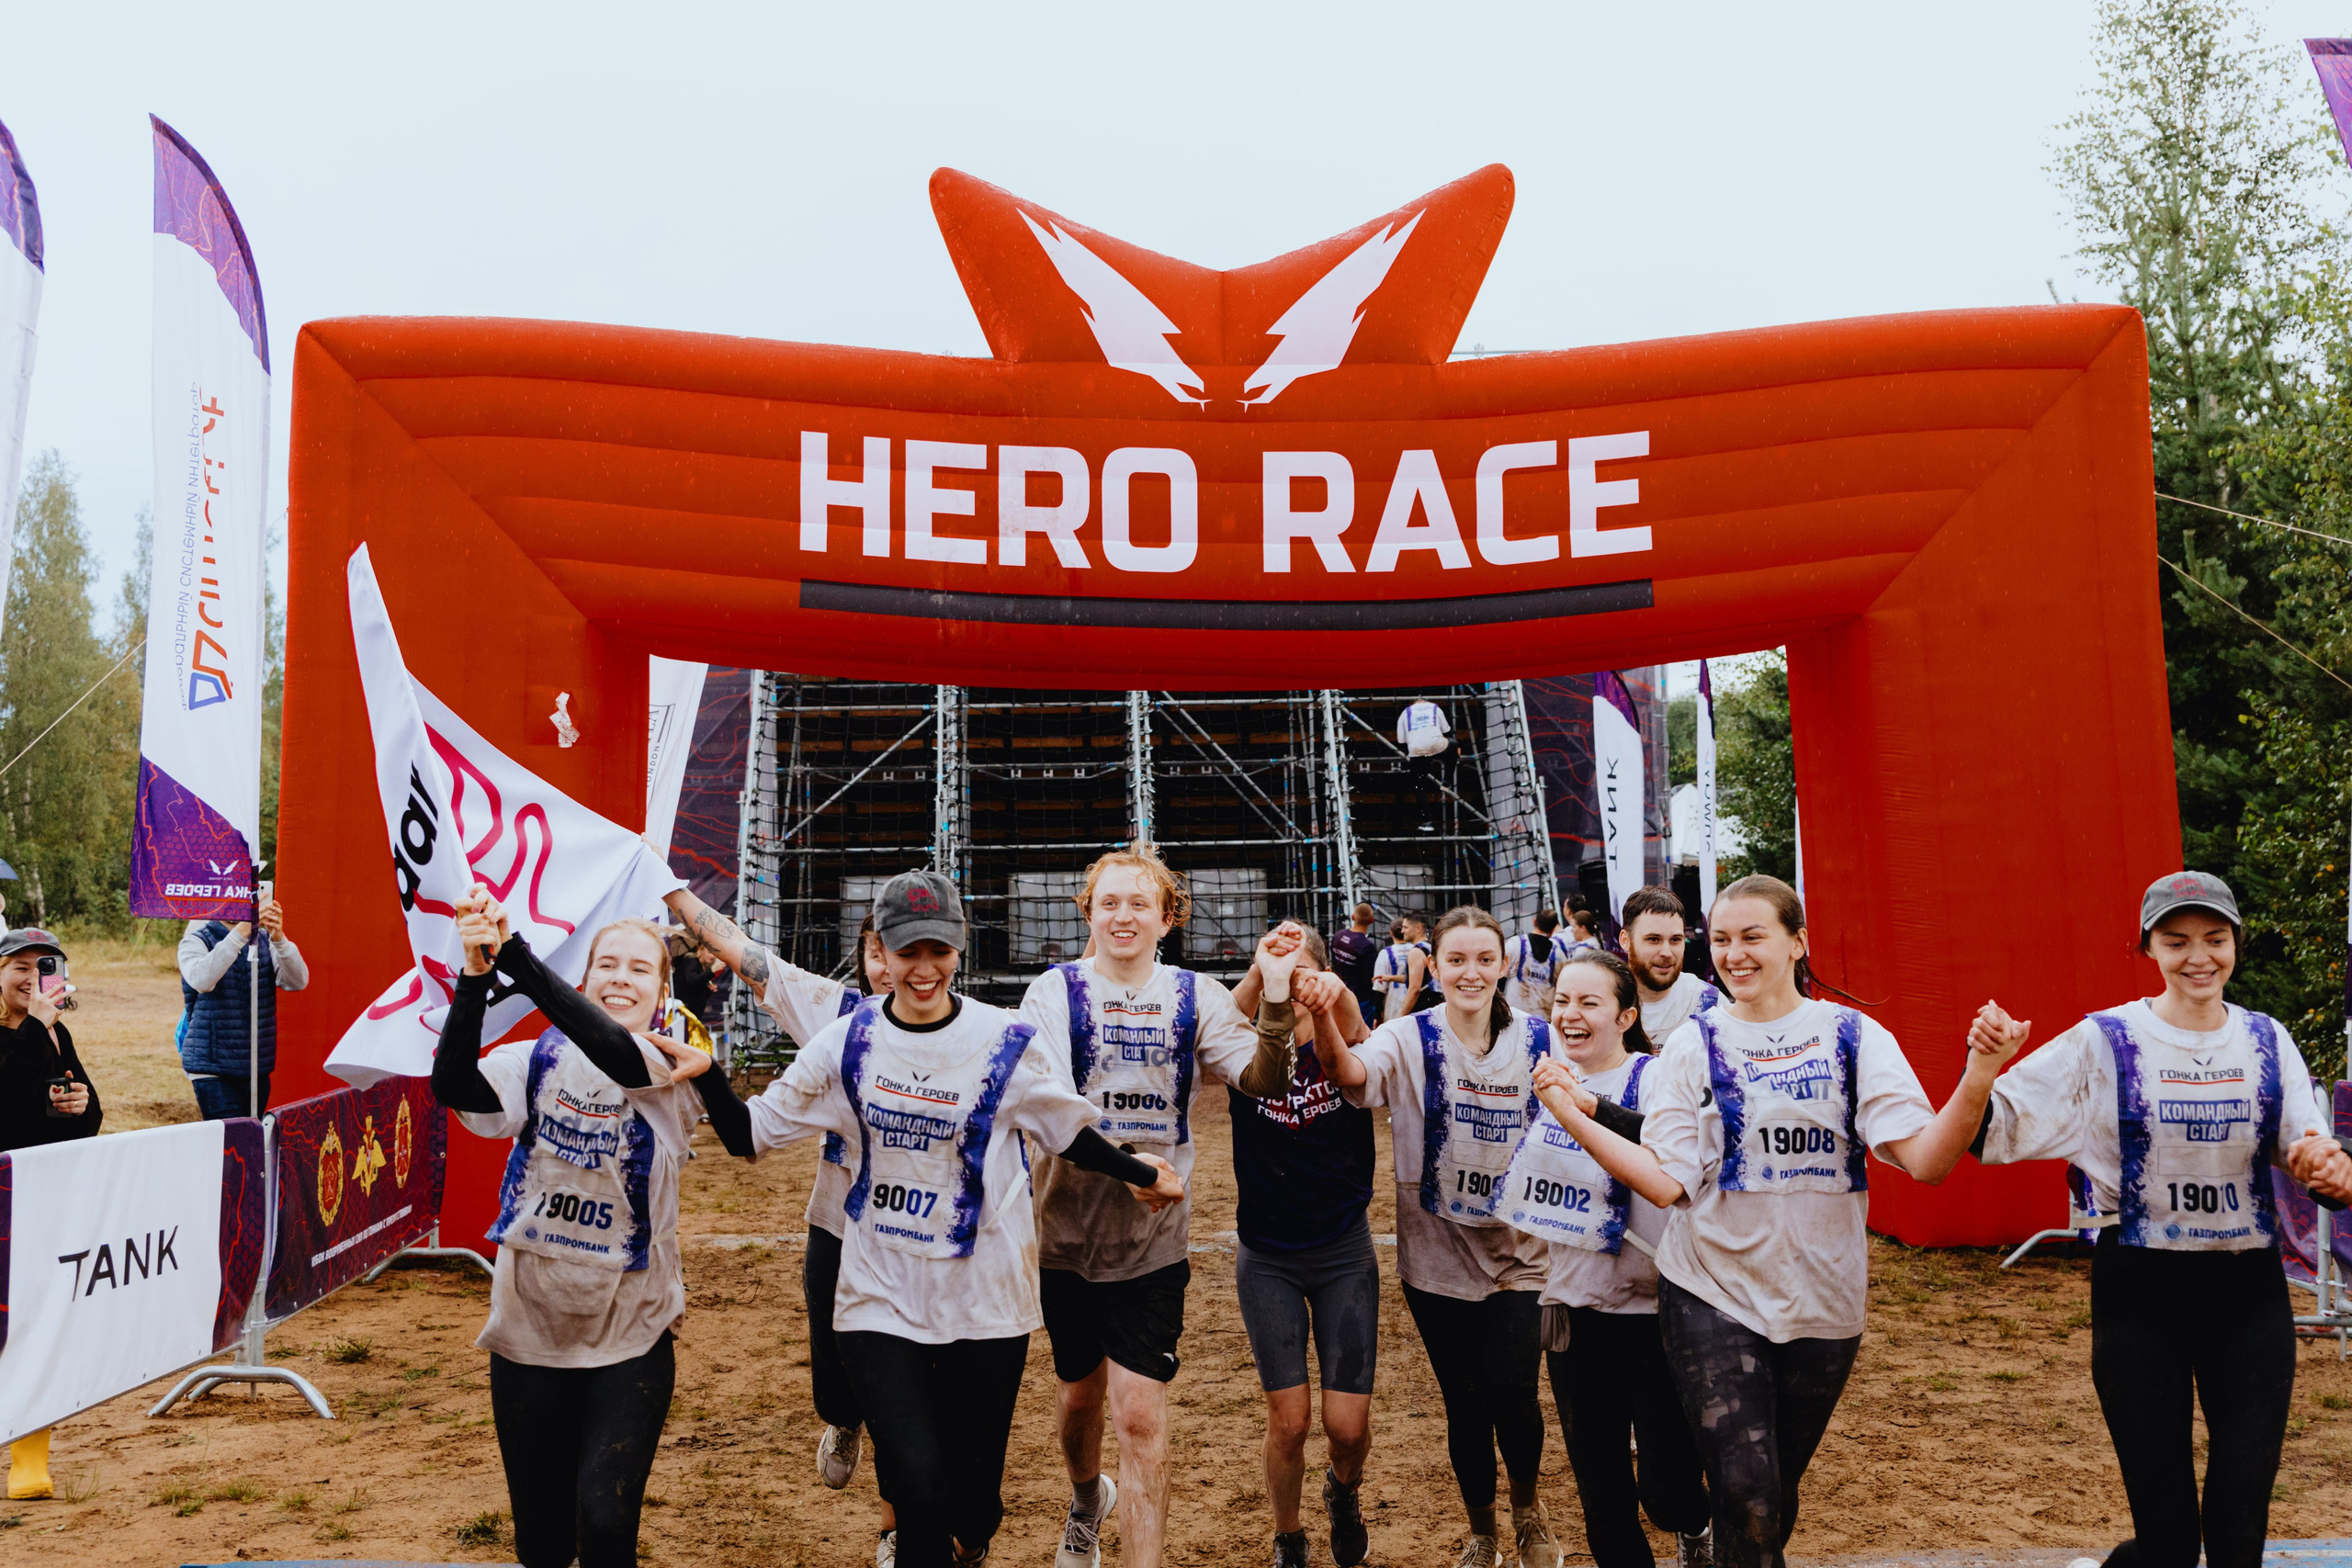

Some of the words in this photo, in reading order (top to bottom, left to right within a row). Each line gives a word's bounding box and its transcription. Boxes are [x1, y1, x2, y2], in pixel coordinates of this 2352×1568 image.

[799, 430, 1198, 573] HERO
[1262, 430, 1653, 573] RACE
[647, 745, 660, 787] ONDON
[1777, 1035, 1820, 1056] ГЕРОЕВ
[1457, 1078, 1487, 1092] ГОНКА
[2159, 1069, 2201, 1081] ГОНКА
[2204, 1068, 2245, 1081] ГЕРОЕВ
[876, 1075, 911, 1095] ГОНКА
[915, 1087, 960, 1102] ГЕРОЕВ
[588, 1103, 622, 1115] ГЕРОЕ
[1257, 1104, 1300, 1124] ГОНКА
[1456, 1105, 1521, 1128] КОМАНДНЫЙ
[2160, 1099, 2250, 1124] КОМАНДНЫЙ
[866, 1105, 955, 1138] КОМАНДНЫЙ
[1117, 1121, 1168, 1132] ГАЗПРОМБАНК
[885, 1131, 928, 1149] СТАРТ
[1475, 1124, 1507, 1141] СТАРТ
[1758, 1126, 1836, 1155] 19008
[558, 1149, 598, 1168] СТАРТ
[1523, 1176, 1591, 1213] 19002
[2167, 1181, 2240, 1213] 19010
[534, 1191, 614, 1230] 19005
[875, 1223, 935, 1243] ГАЗПРОМБАНК
[1529, 1215, 1587, 1235] ГАЗПРОМБАНК
[2188, 1226, 2252, 1240] ГАЗПРОМБАНК
[544, 1233, 611, 1254] ГАЗПРОМБАНК
[58, 1224, 179, 1303] TANK
